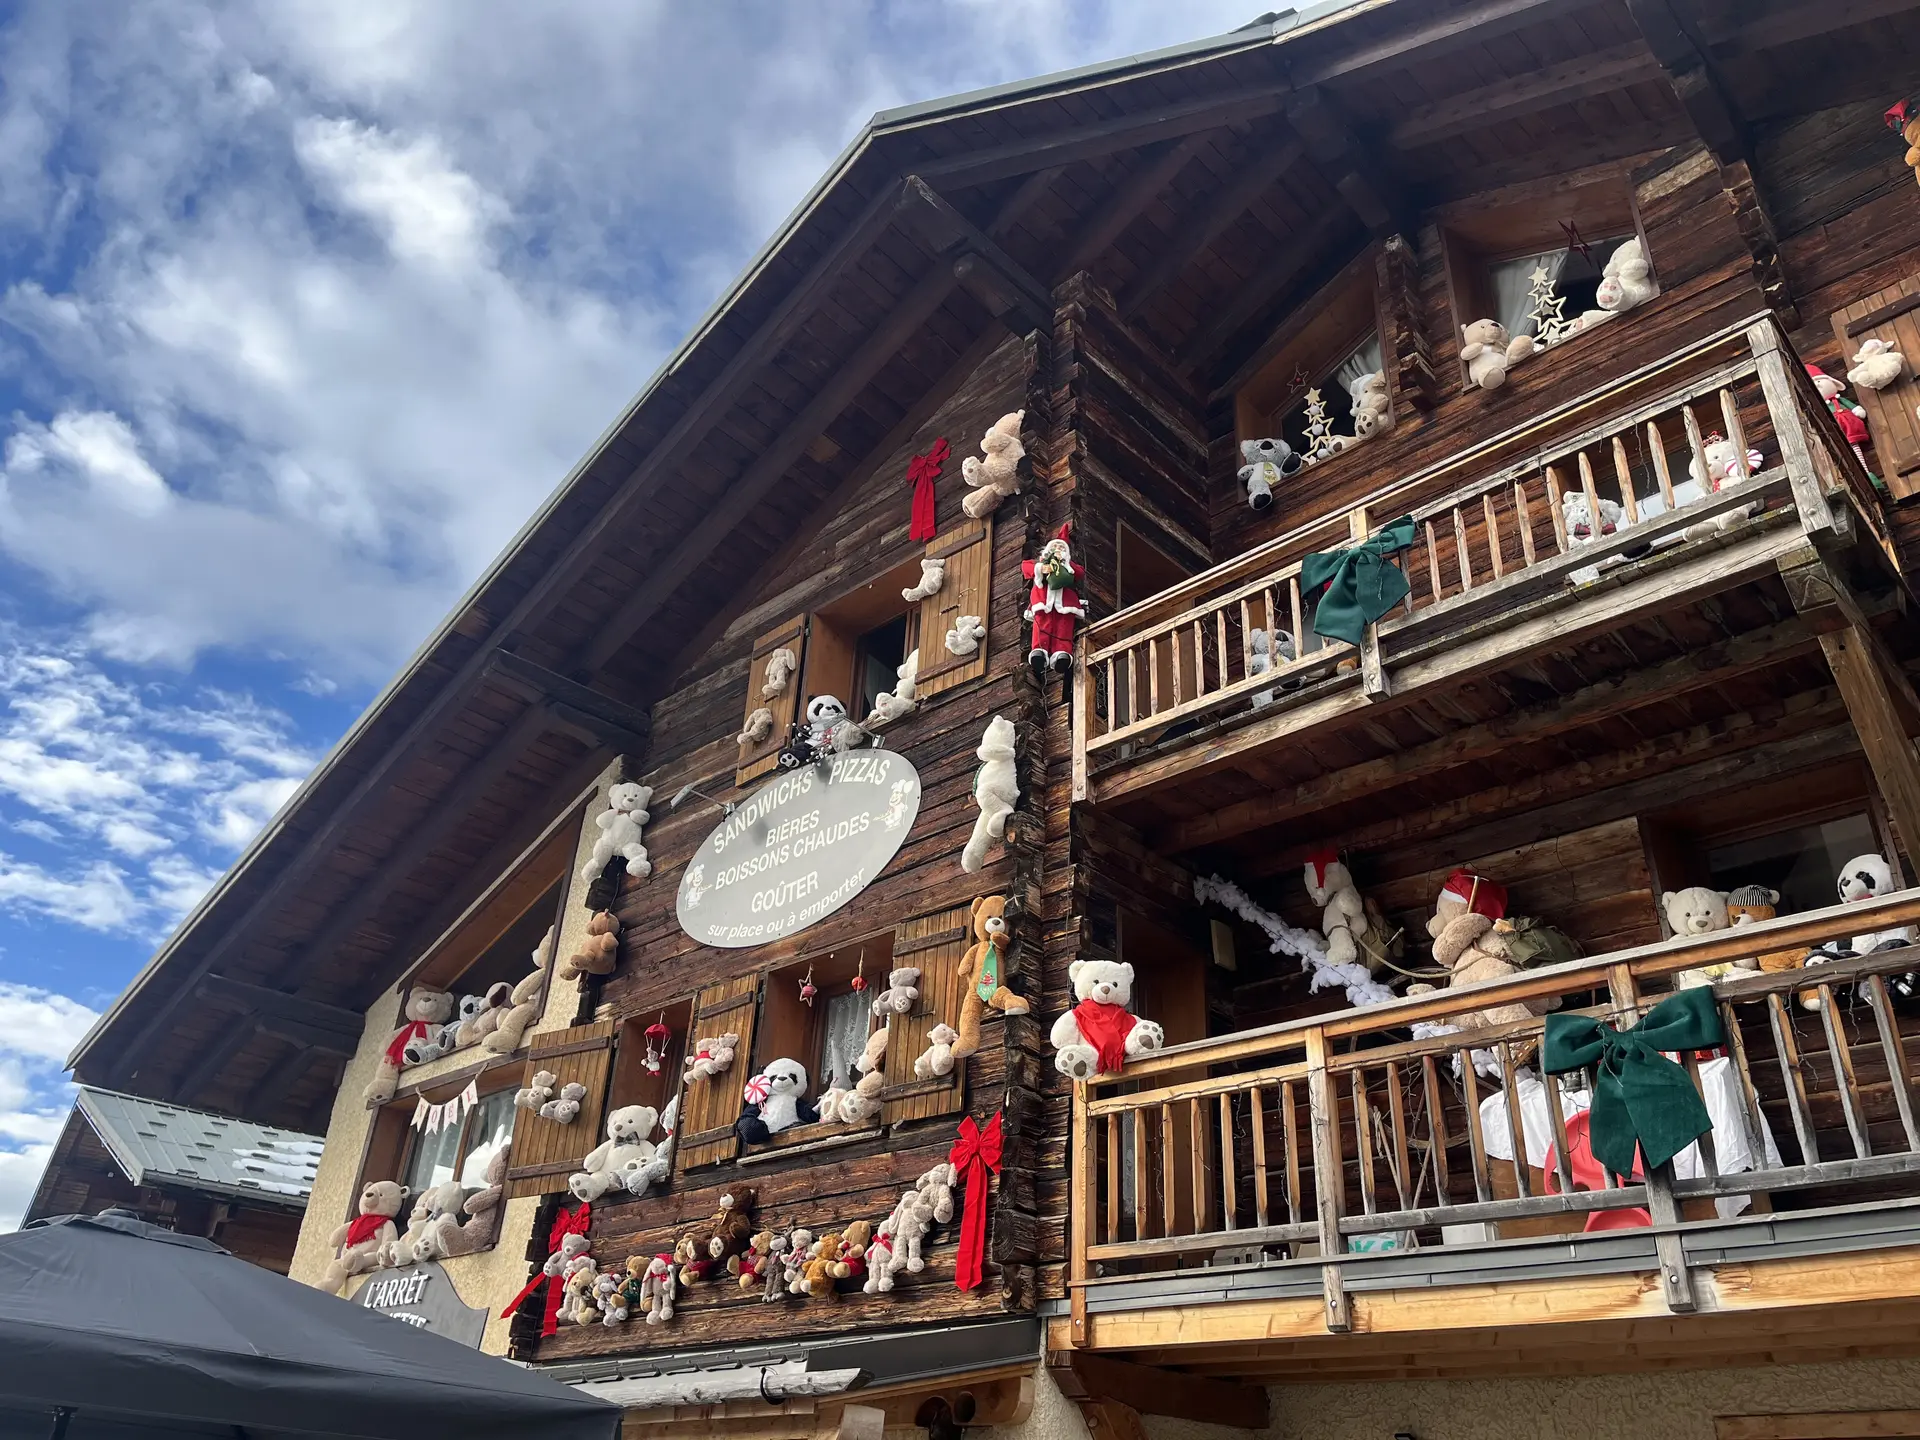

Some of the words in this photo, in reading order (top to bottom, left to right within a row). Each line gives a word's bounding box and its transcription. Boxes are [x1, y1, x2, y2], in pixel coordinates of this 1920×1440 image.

[714, 771, 813, 853] SANDWICHS
[829, 758, 890, 785] PIZZAS
[765, 809, 819, 847] BIÈRES
[715, 845, 789, 890] BOISSONS
[793, 812, 870, 858] CHAUDES
[707, 922, 728, 936] sur
[727, 919, 763, 940] place
[766, 918, 784, 933] ou
[787, 911, 795, 926] à
[799, 868, 865, 921] emporter
[751, 871, 818, 913] GOÛTER
[363, 1269, 428, 1308] L'ARRÊT
